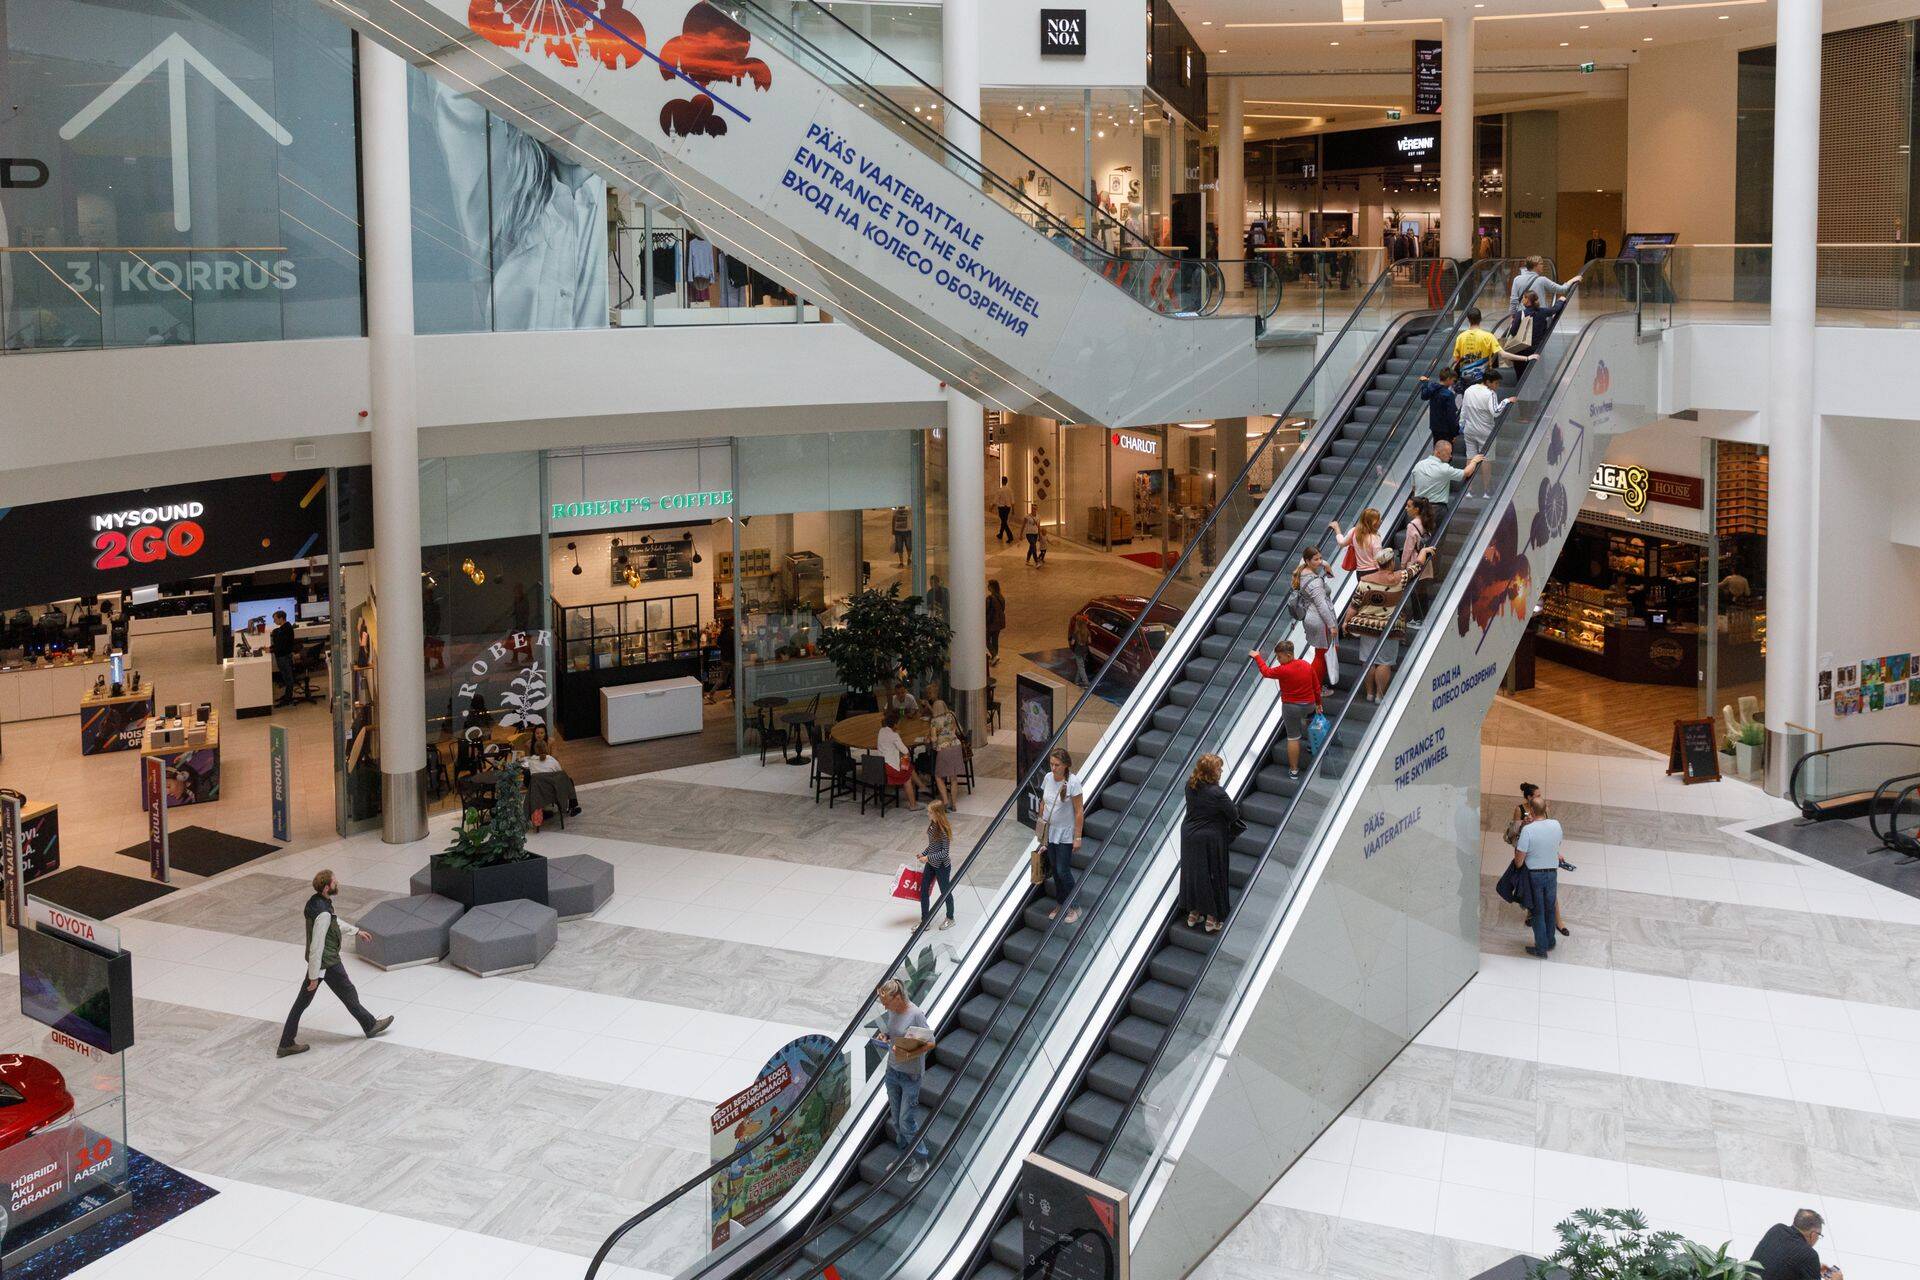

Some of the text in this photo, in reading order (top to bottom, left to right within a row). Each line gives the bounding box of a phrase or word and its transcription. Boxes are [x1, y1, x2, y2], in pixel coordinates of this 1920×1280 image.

[1048, 19, 1079, 32] NOA
[1048, 32, 1079, 45] NOA
[806, 122, 984, 251] PÄÄS VAATERATTALE
[794, 146, 1040, 318] ENTRANCE TO THE SKYWHEEL
[782, 170, 1029, 338] ВХОД НА КОЛЕСО ОБОЗРЕНИЯ
[66, 260, 297, 292] 3. KORRUS
[1120, 434, 1157, 454] CHARLOT
[1655, 482, 1690, 497] HOUSE
[95, 502, 204, 531] MYSOUND
[552, 490, 734, 519] ROBERT'S COFFEE
[94, 520, 205, 570] 2GO
[1432, 665, 1460, 692] ВХОД НА
[1432, 662, 1496, 712] КОЛЕСО ОБОЗРЕНИЯ
[120, 730, 144, 740] NOIS
[128, 738, 142, 747] OF
[1394, 727, 1444, 771] ENTRANCE TO
[1394, 746, 1449, 792] THE SKYWHEEL
[1363, 812, 1384, 838] PÄÄS
[1364, 806, 1422, 860] VAATERATTALE
[6, 831, 14, 875] NAUDI.
[903, 880, 921, 892] SA
[49, 910, 94, 940] TOYOTA
[734, 1079, 766, 1108] RESTORAN
[768, 1065, 787, 1082] KOOS
[715, 1107, 740, 1130] LOTTE
[76, 1136, 112, 1171] 10
[11, 1162, 58, 1190] HÜBRIIDI
[74, 1156, 114, 1183] AASTAT
[11, 1184, 34, 1201] AKU
[12, 1180, 62, 1211] GARANTII
[1028, 1193, 1034, 1204] 5
[1028, 1220, 1034, 1230] 4
[1029, 1254, 1036, 1266] 3
